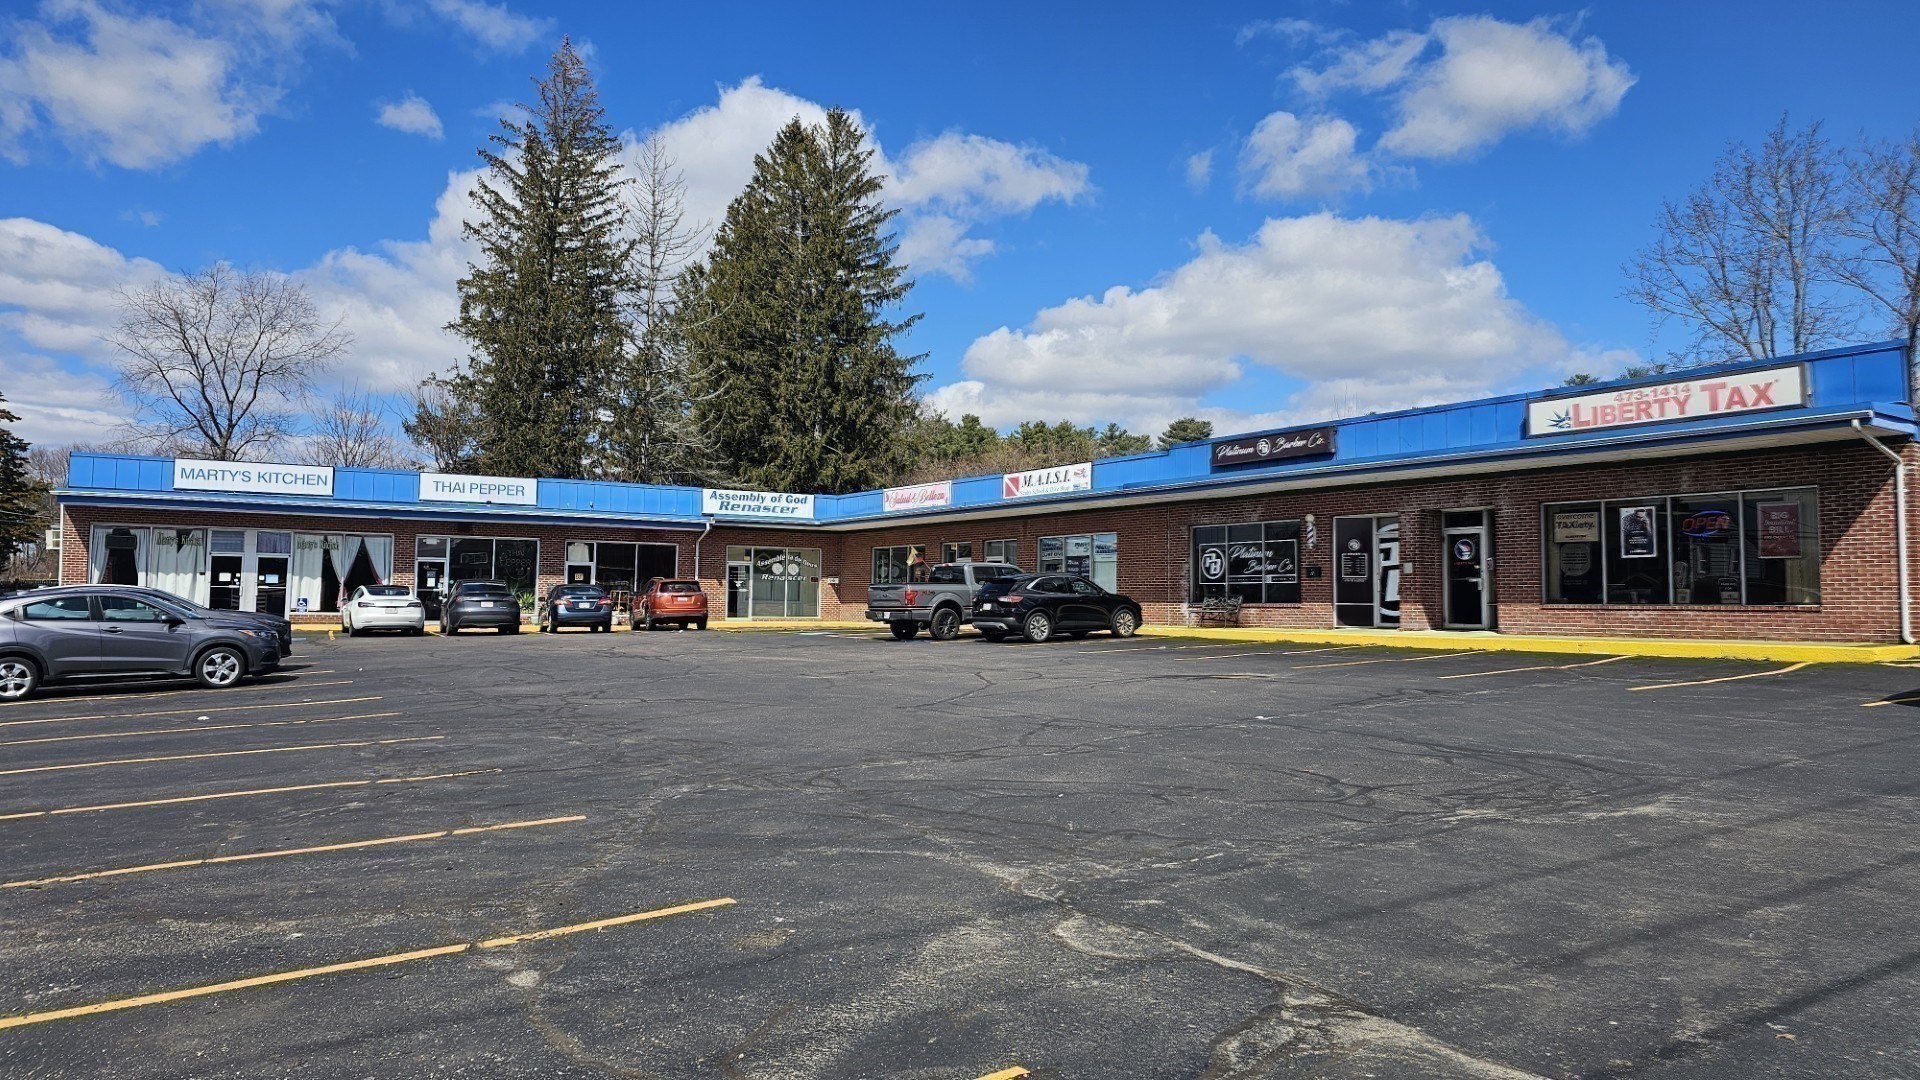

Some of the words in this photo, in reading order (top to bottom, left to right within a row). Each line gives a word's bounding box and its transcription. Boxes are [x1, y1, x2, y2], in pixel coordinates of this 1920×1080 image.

[1613, 383, 1690, 402] 473-1414
[1572, 393, 1691, 428] LIBERTY
[1699, 381, 1776, 412] TAX
[1215, 444, 1254, 459] Platinum
[1272, 436, 1307, 453] Barber
[180, 467, 252, 483] MARTY'S
[257, 471, 328, 486] KITCHEN
[433, 480, 465, 494] THAI
[469, 482, 525, 497] PEPPER
[709, 490, 766, 504] Assembly
[770, 493, 784, 503] of
[785, 494, 808, 504] God
[719, 500, 798, 514] Renascer
[1682, 515, 1730, 531] OPEN
[1228, 545, 1274, 561] Platinum
[1243, 559, 1277, 574] Barber
[761, 573, 808, 581] Renascer
